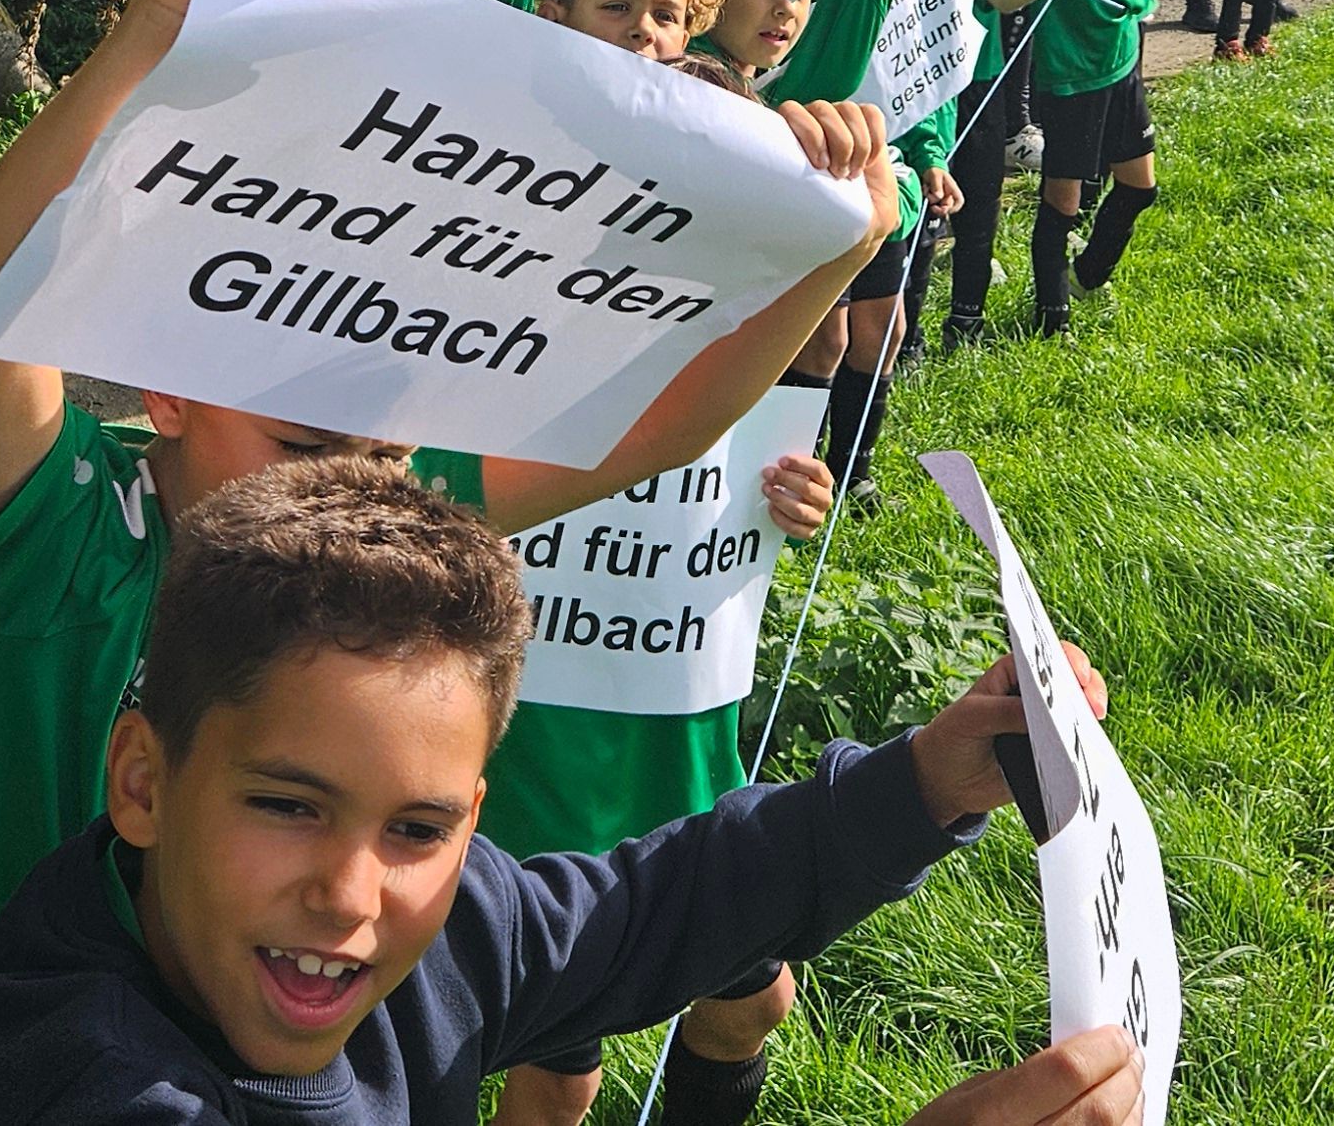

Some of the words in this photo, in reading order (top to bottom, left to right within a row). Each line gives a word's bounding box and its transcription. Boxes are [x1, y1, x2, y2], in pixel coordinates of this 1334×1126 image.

[891, 10, 964, 77] Zukunft
[891, 42, 968, 116] gestalte
[340, 88, 612, 213] Hand
[596, 177, 694, 246] in
[136, 140, 417, 247] Hand
[410, 216, 553, 284] für
[556, 256, 715, 326] den
[188, 249, 549, 377] Gillbach
[583, 525, 672, 578] für
[686, 527, 760, 578] den
